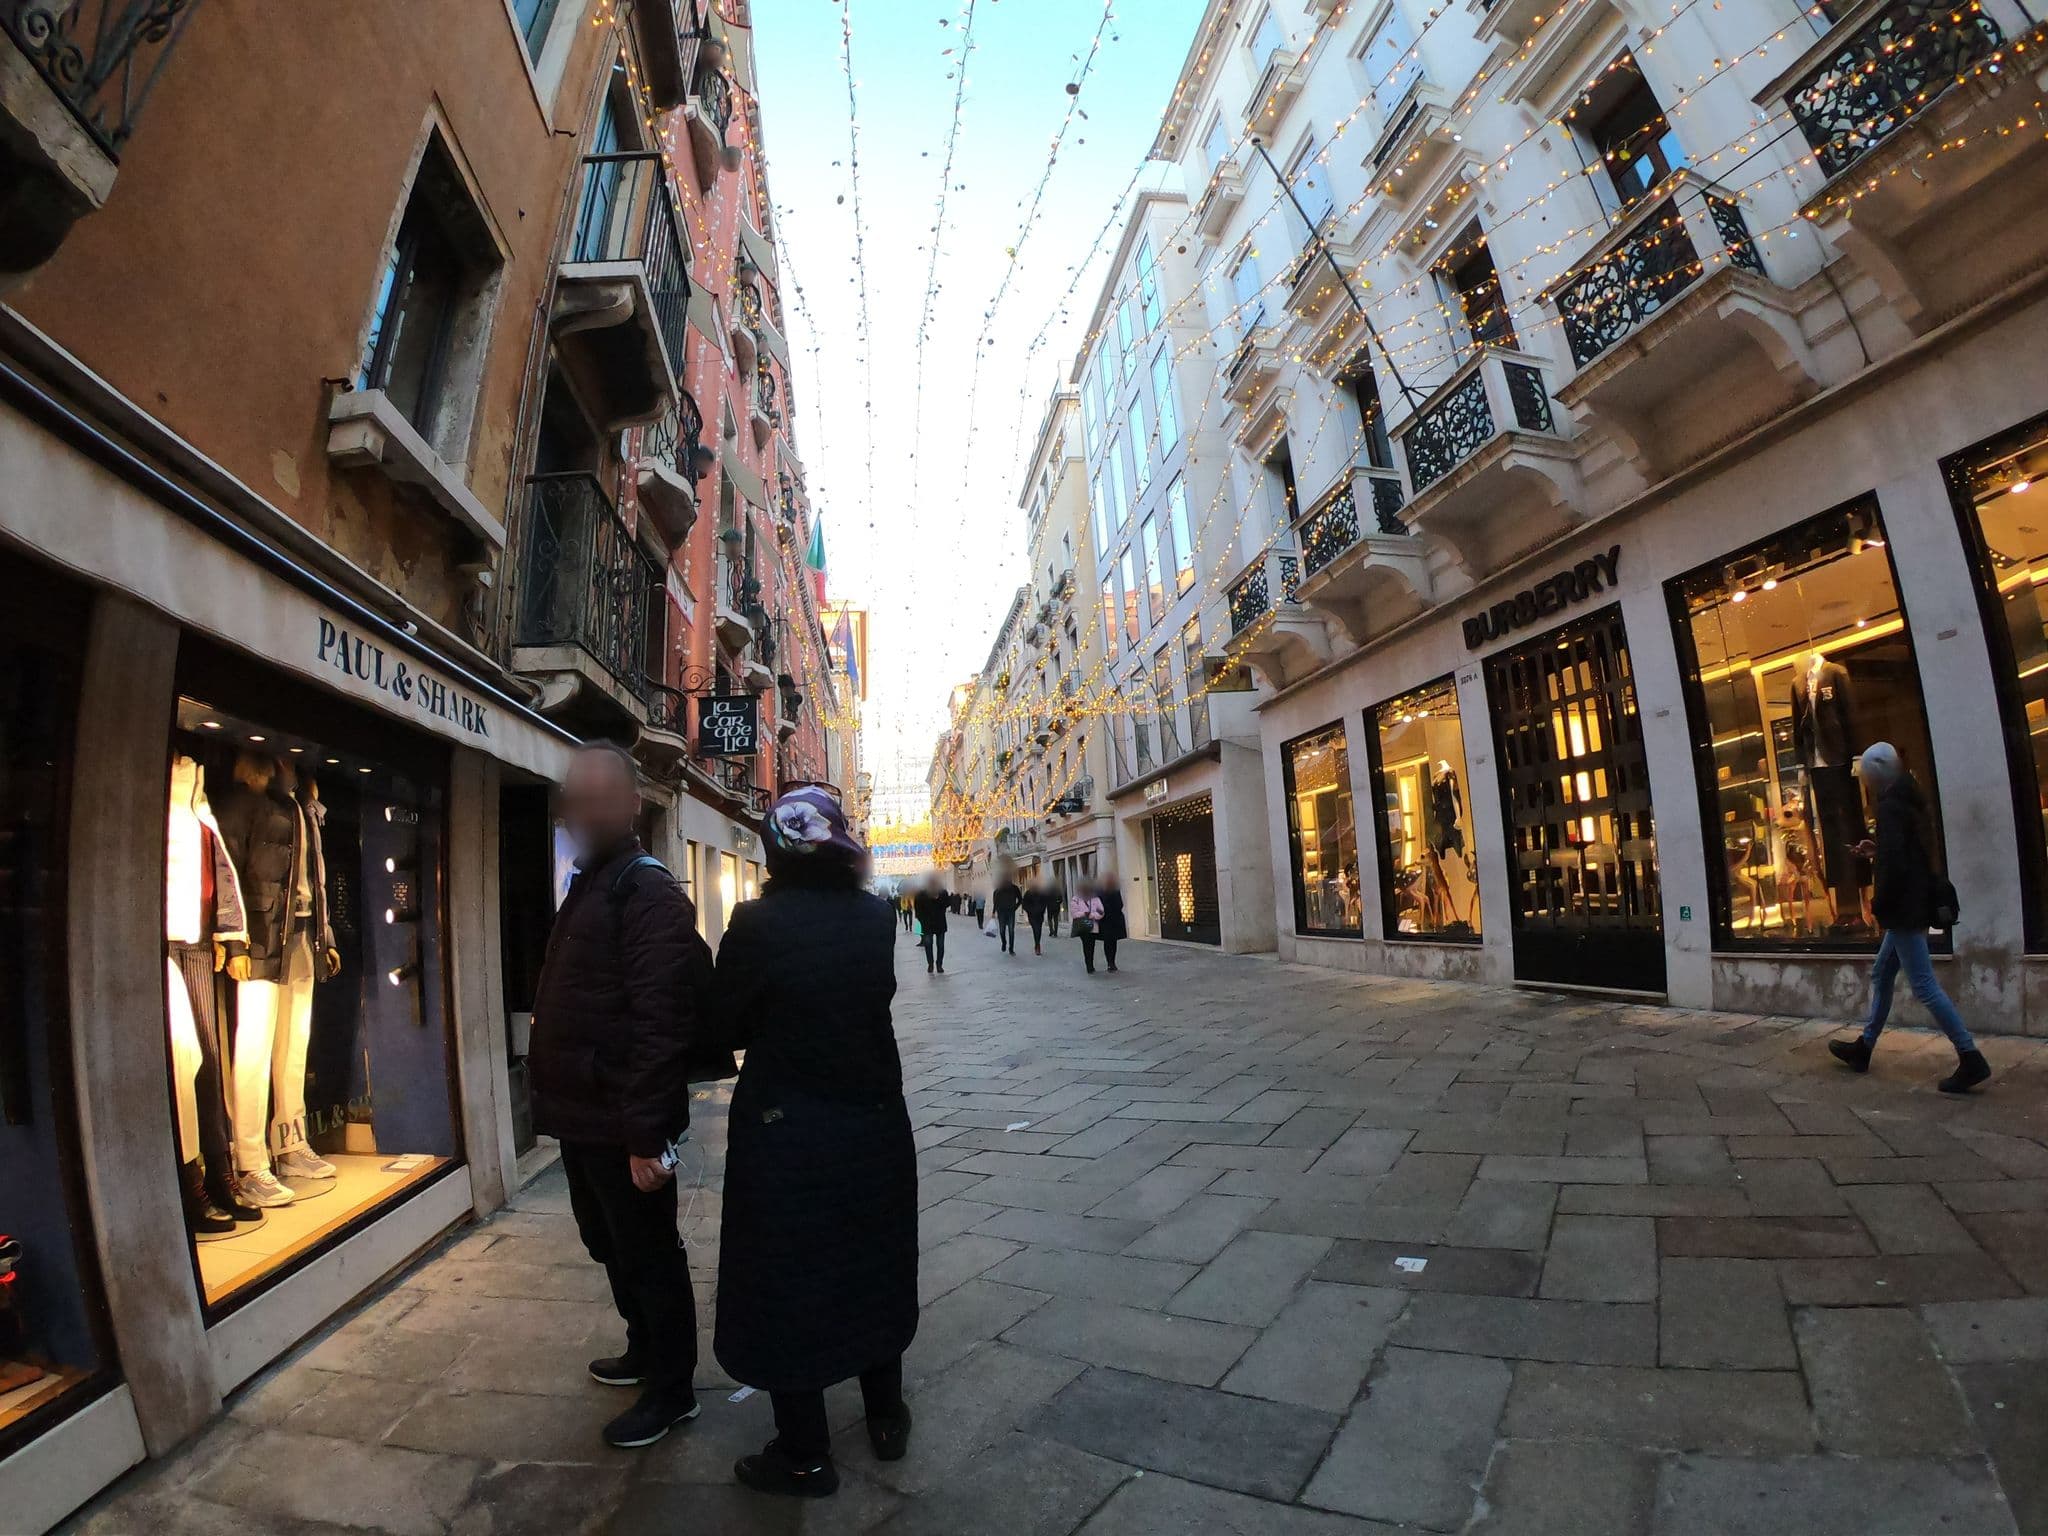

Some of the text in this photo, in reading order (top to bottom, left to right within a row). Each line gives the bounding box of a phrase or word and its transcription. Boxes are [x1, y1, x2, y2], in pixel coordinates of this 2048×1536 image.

[1462, 544, 1621, 650] BURBERRY
[317, 616, 490, 738] PAUL & SHARK
[278, 1109, 328, 1148] PAUL
